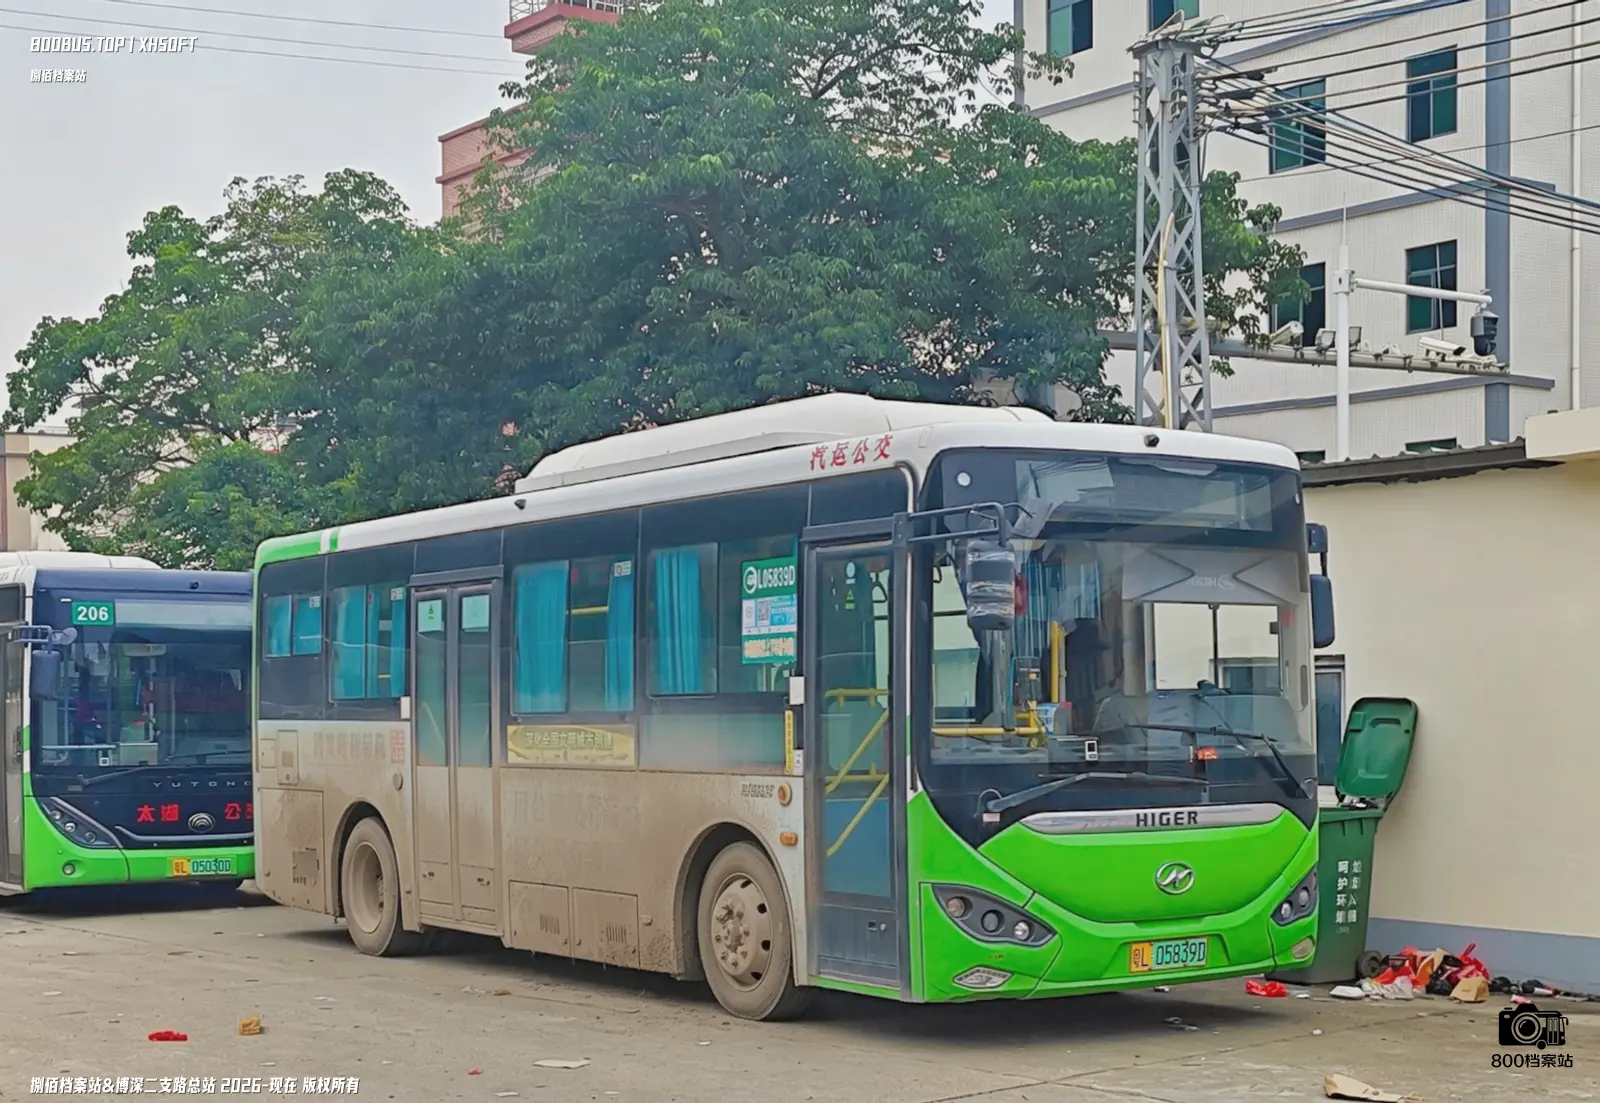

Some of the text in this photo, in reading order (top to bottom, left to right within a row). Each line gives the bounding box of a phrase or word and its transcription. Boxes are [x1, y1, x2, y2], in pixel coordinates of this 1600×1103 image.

[810, 434, 893, 471] 汽运公交
[757, 565, 796, 589] L05839D
[77, 606, 109, 621] 206
[1136, 811, 1198, 827] HIGER
[1155, 941, 1206, 966] 05839D
